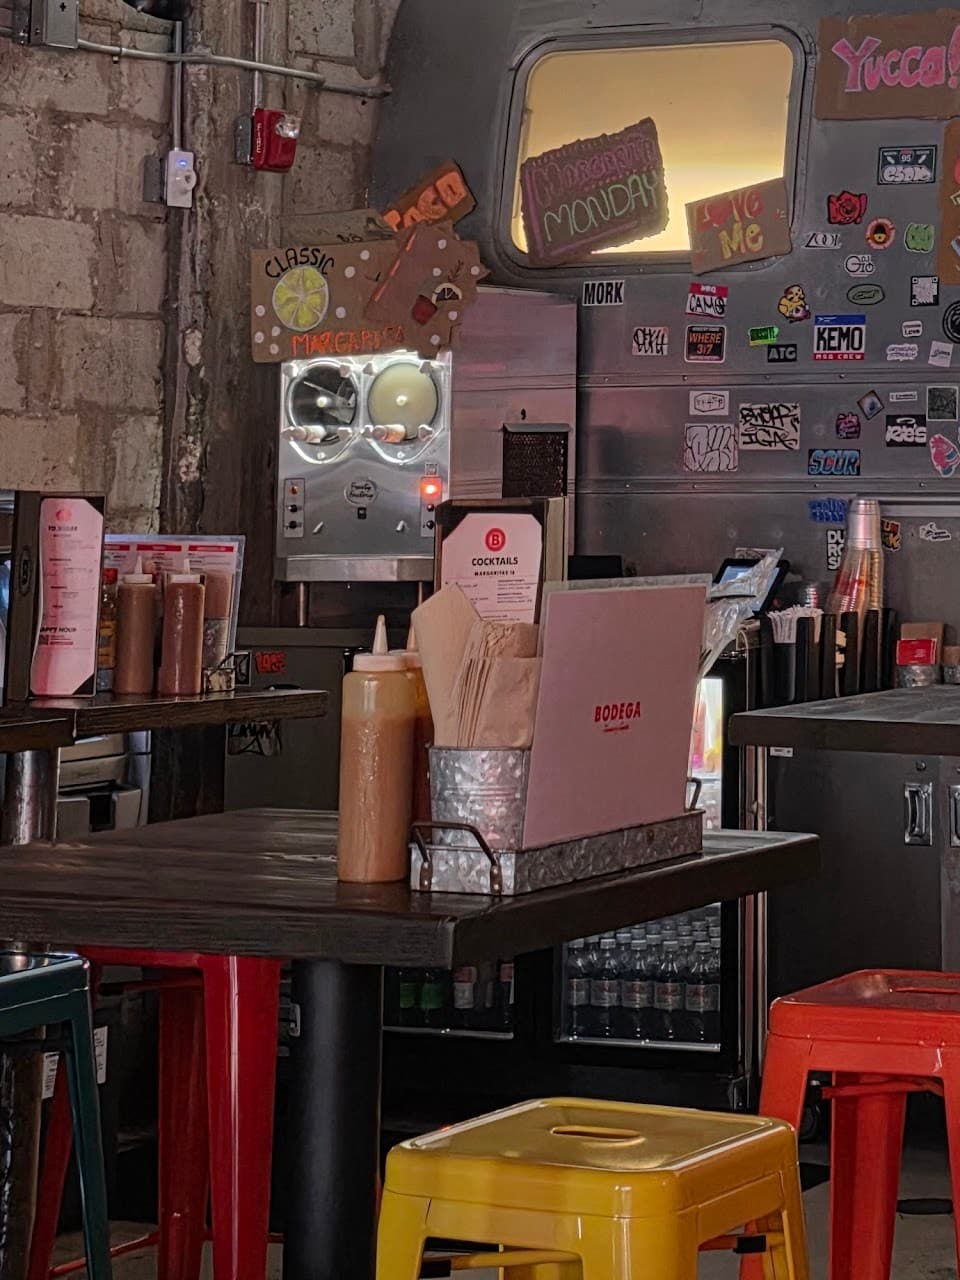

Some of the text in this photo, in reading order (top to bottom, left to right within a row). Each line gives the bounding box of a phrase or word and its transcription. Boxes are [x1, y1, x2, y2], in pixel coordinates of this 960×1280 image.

[543, 169, 660, 242] MONDAY
[265, 248, 335, 278] CLASSIC
[583, 281, 624, 305] MORK
[689, 333, 721, 344] WHERE
[816, 326, 863, 352] KEMO
[769, 347, 796, 359] ATG
[471, 556, 519, 567] COCKTAILS
[594, 701, 641, 722] BODEGA
